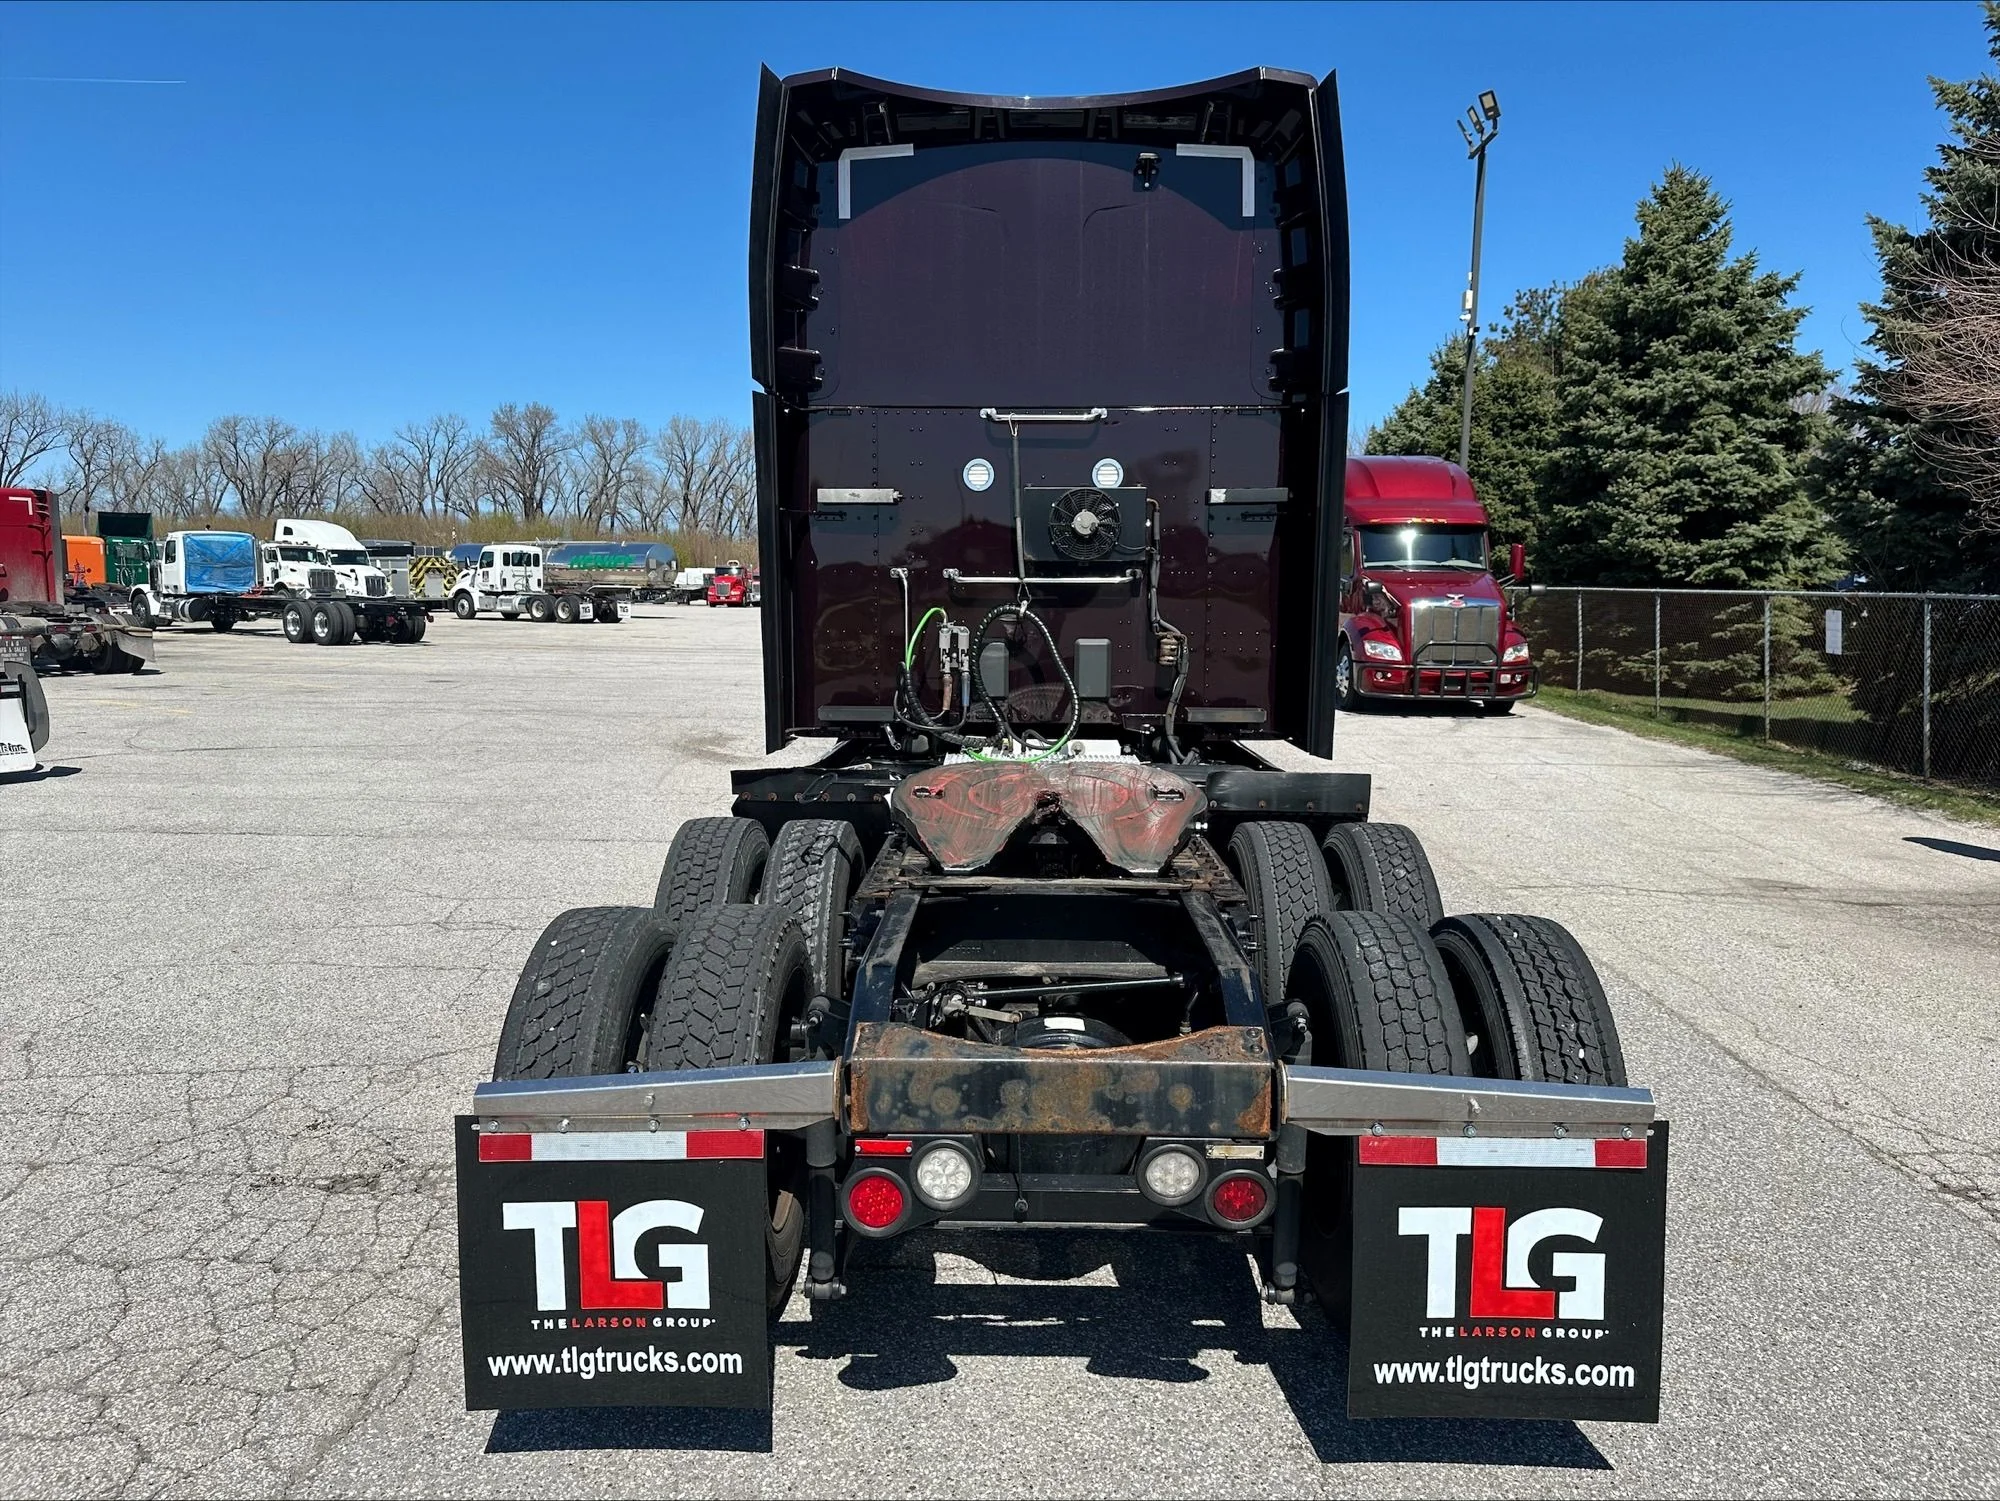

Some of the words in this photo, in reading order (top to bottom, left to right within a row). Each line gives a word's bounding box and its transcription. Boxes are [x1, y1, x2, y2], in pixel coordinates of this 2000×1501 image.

[502, 1199, 711, 1312] TLG
[1398, 1206, 1607, 1320] TLG
[531, 1318, 568, 1330] THE
[571, 1316, 647, 1329] LARSON
[652, 1316, 712, 1328] GROUP
[1418, 1326, 1455, 1338] THE
[1459, 1326, 1536, 1338] LARSON
[1541, 1327, 1604, 1339] GROUP
[487, 1345, 743, 1380] www.tlgtrucks.com
[1373, 1354, 1635, 1390] www.tlgtrucks.com
